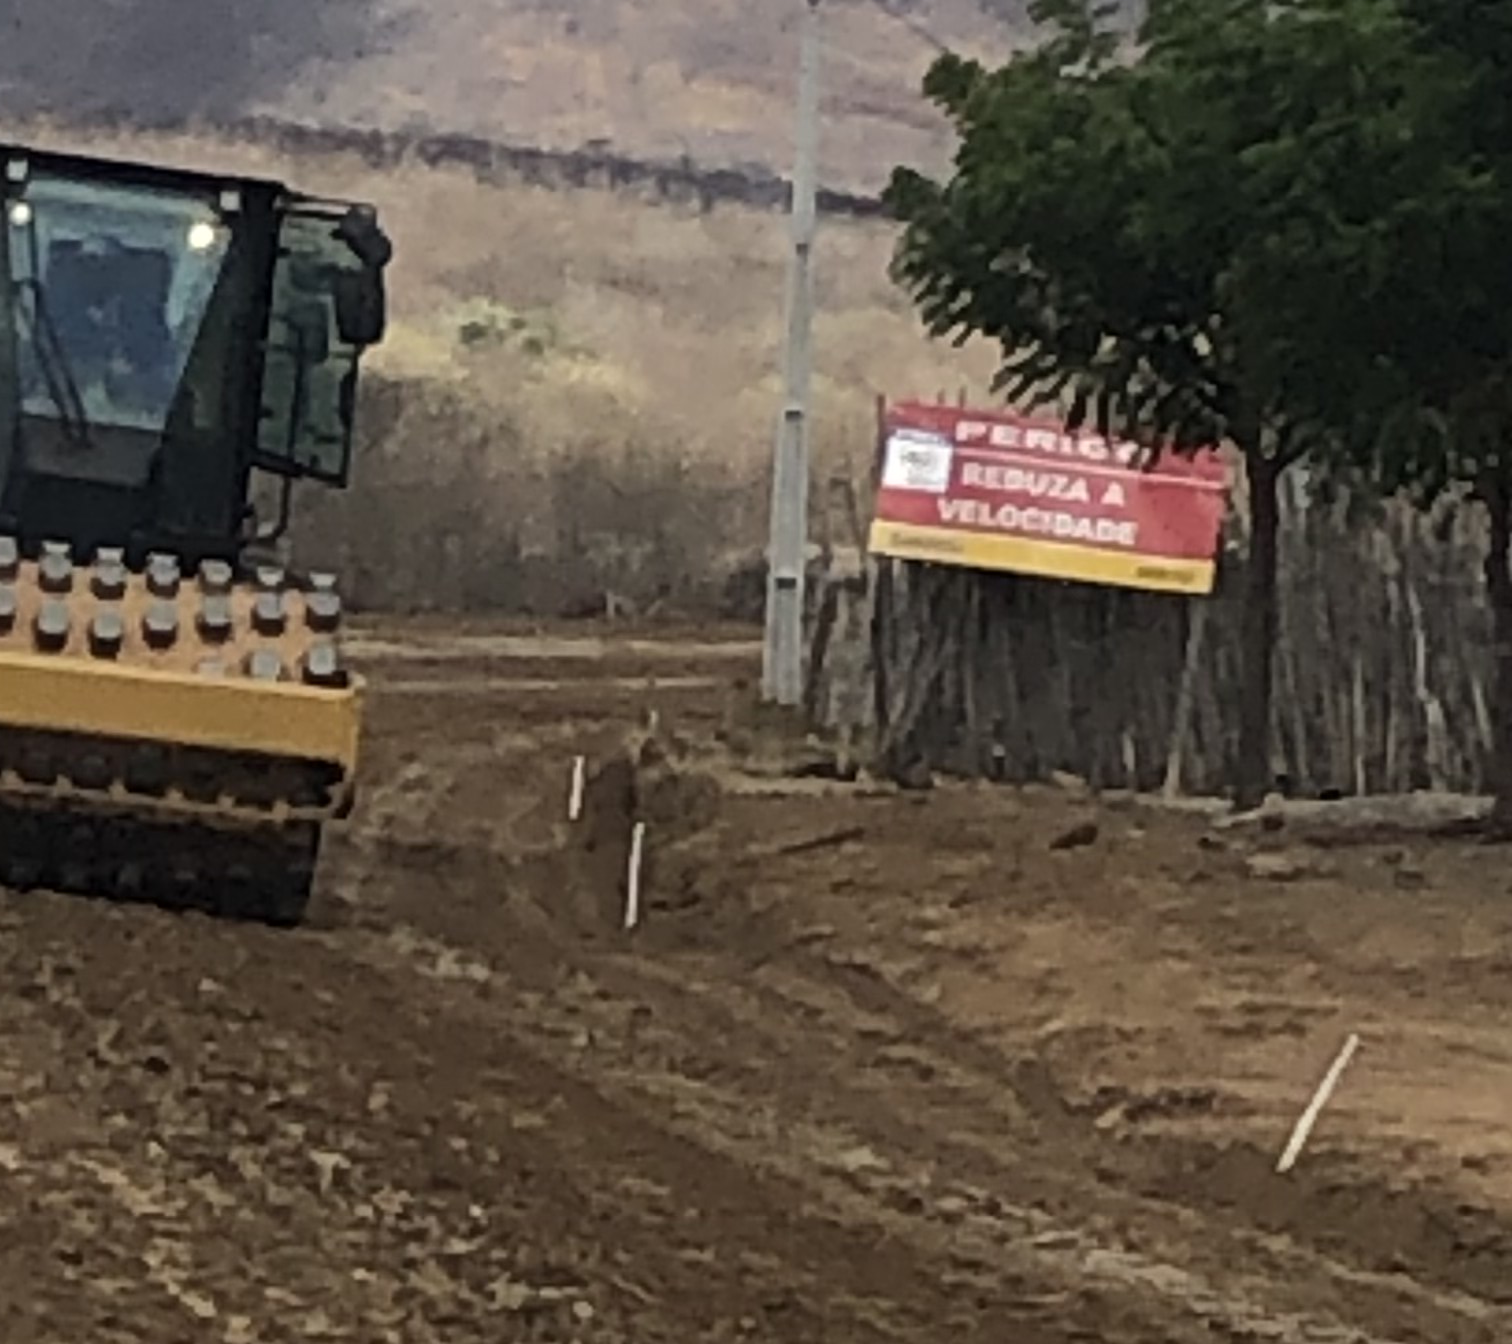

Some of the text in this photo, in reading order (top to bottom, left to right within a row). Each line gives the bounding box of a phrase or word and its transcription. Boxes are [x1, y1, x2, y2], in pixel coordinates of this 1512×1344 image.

[962, 462, 1089, 502] REDUZA
[1100, 481, 1125, 506] A
[937, 498, 1138, 545] VELOCIDADE
